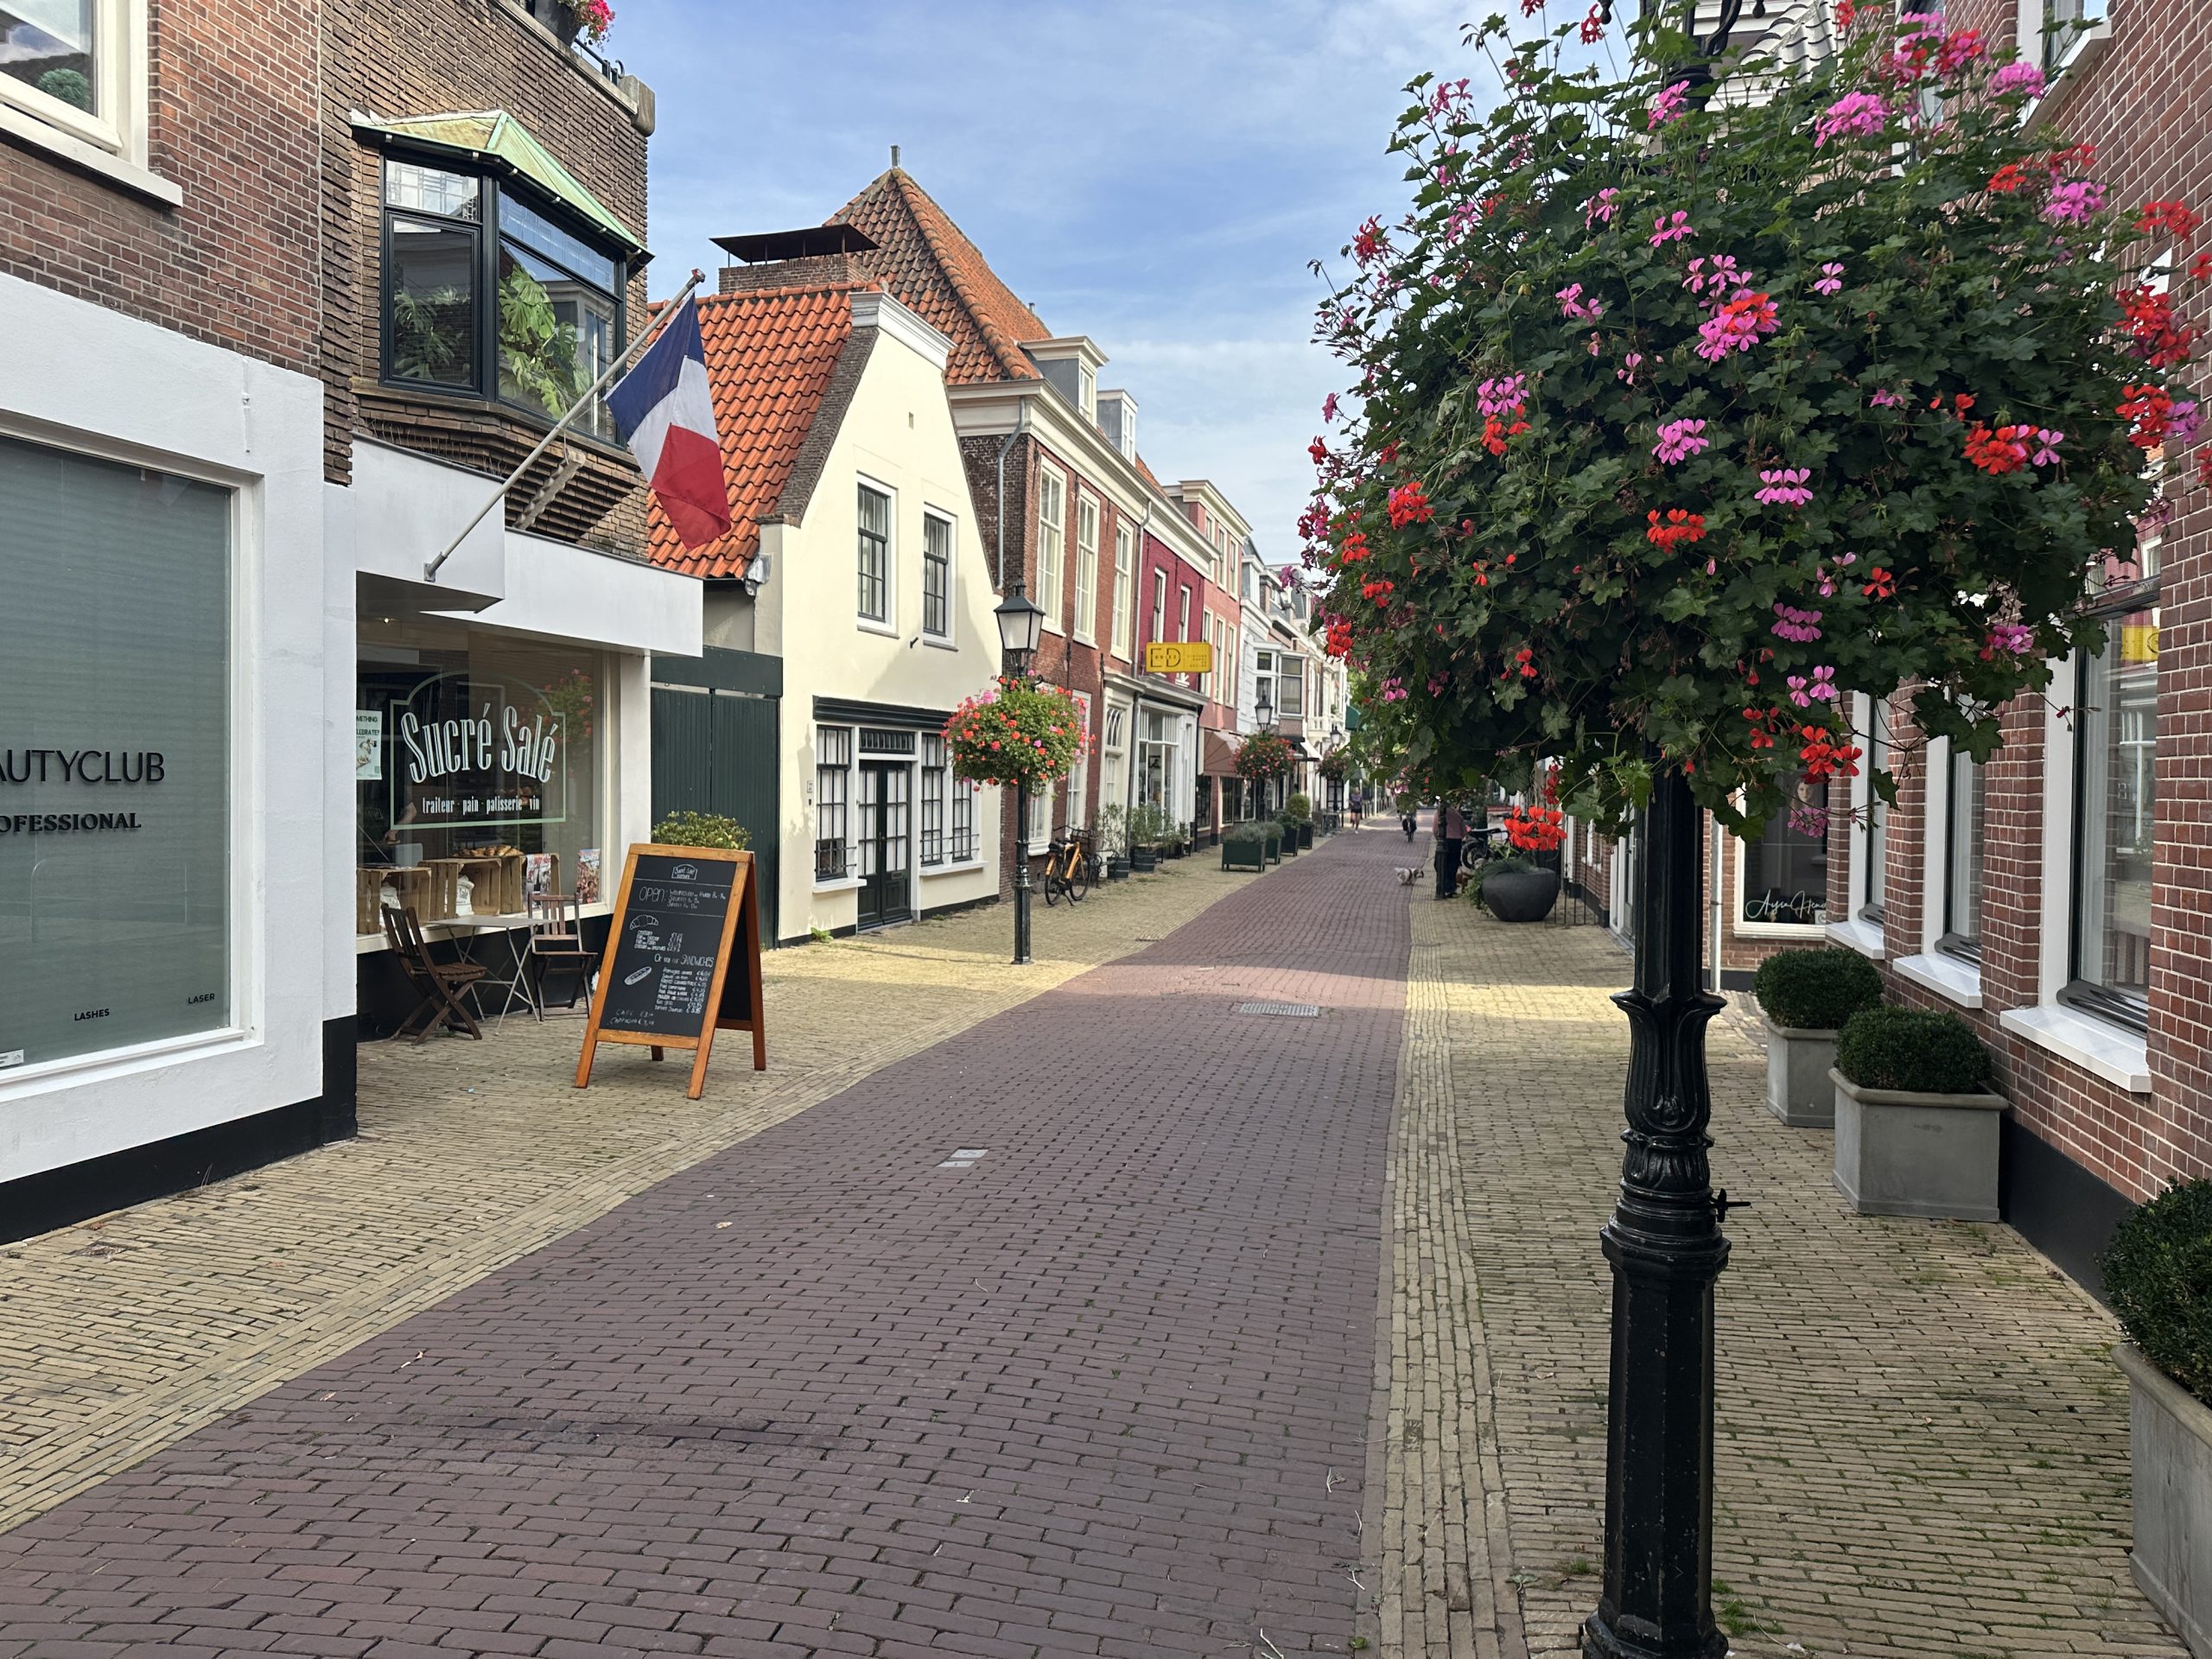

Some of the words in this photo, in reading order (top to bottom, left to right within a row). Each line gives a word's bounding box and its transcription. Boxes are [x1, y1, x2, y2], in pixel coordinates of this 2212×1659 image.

[401, 702, 492, 784] Sucré
[501, 705, 558, 783] Salé
[0, 749, 165, 782] UTYCLUB
[422, 797, 455, 814] traiteur
[462, 795, 480, 816] pain
[486, 795, 523, 814] patisserie
[188, 993, 215, 1004] LASER
[73, 1008, 111, 1021] LASHES
